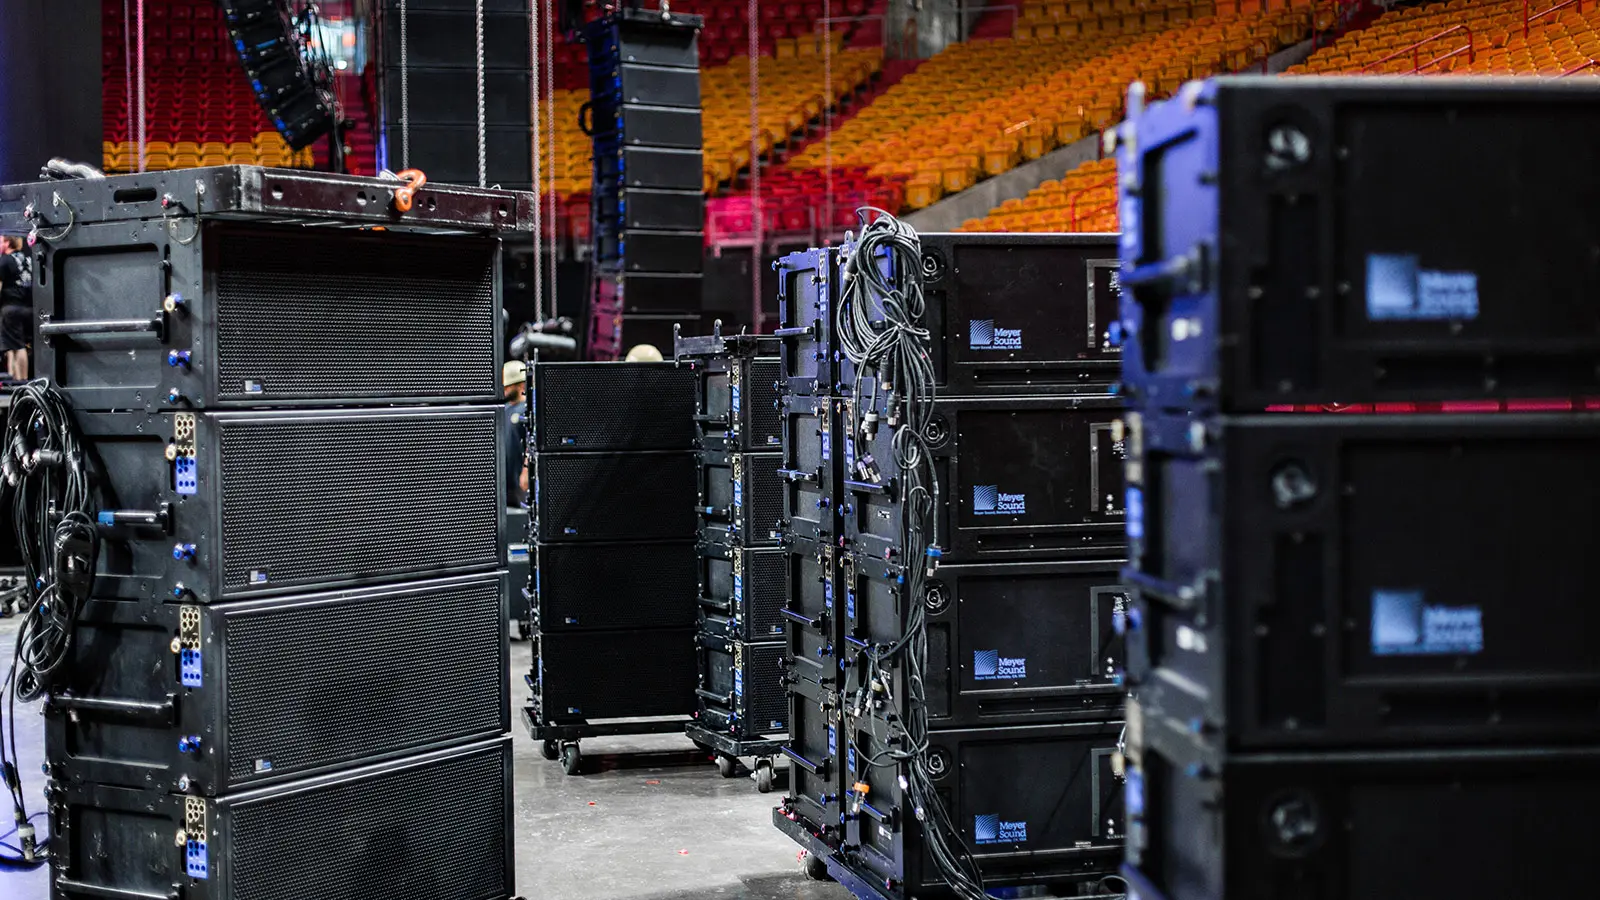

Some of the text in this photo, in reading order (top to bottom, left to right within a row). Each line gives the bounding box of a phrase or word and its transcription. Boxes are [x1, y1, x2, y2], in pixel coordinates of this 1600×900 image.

[994, 328, 1021, 337] Meyer
[994, 337, 1021, 345] Sound
[998, 493, 1025, 502] Meyer
[998, 501, 1025, 510] Sound
[998, 658, 1026, 667] Meyer
[998, 666, 1026, 675] Sound
[1000, 821, 1026, 830] Meyer
[999, 829, 1026, 838] Sound
